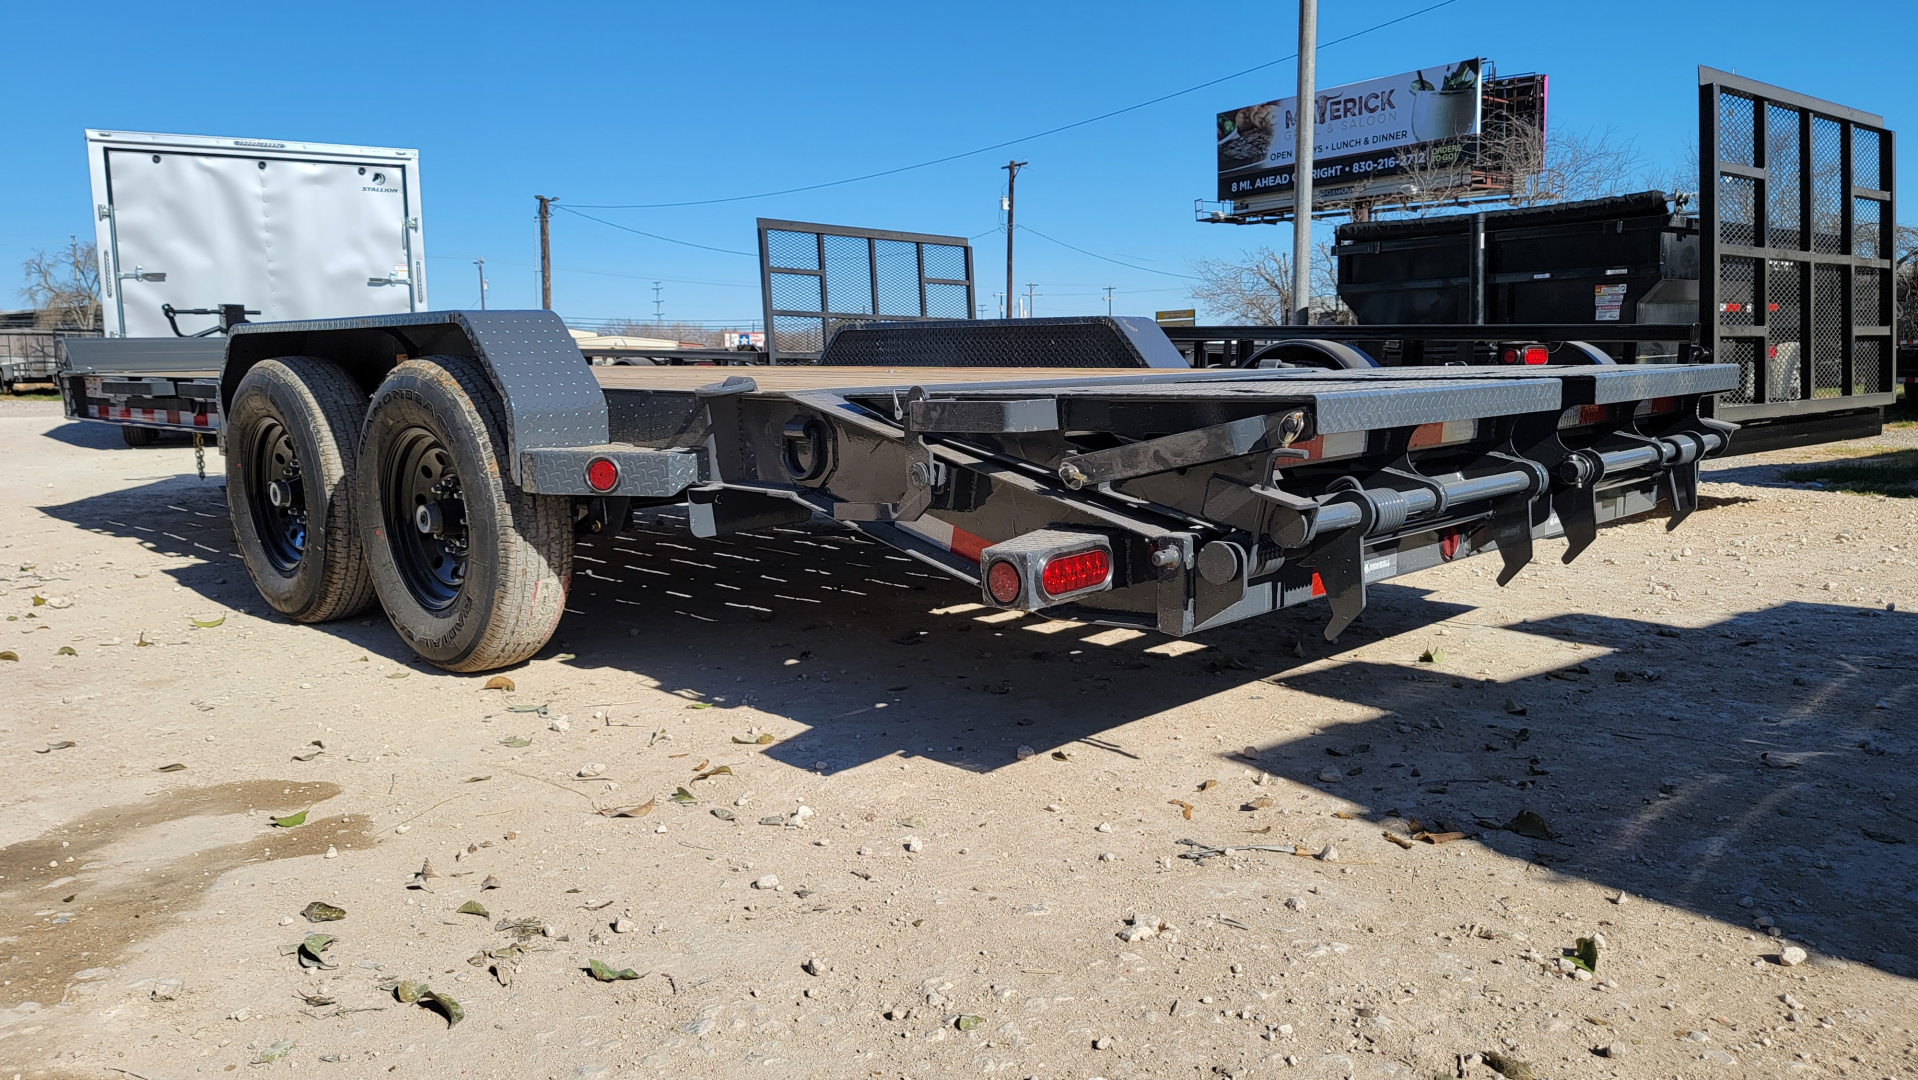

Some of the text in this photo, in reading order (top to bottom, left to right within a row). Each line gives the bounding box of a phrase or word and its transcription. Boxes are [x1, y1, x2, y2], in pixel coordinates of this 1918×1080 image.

[1327, 111, 1397, 133] & SALOON
[1270, 150, 1292, 161] OPEN
[1331, 138, 1361, 151] LUNCH
[1364, 137, 1369, 145] &
[1372, 130, 1408, 144] DINNER
[1432, 144, 1462, 155] ORDERS
[1231, 181, 1238, 192] 8
[1239, 179, 1253, 191] MI.
[1254, 173, 1290, 189] AHEAD
[1312, 165, 1343, 180] RIGHT
[420, 593, 474, 648] RADIAL
